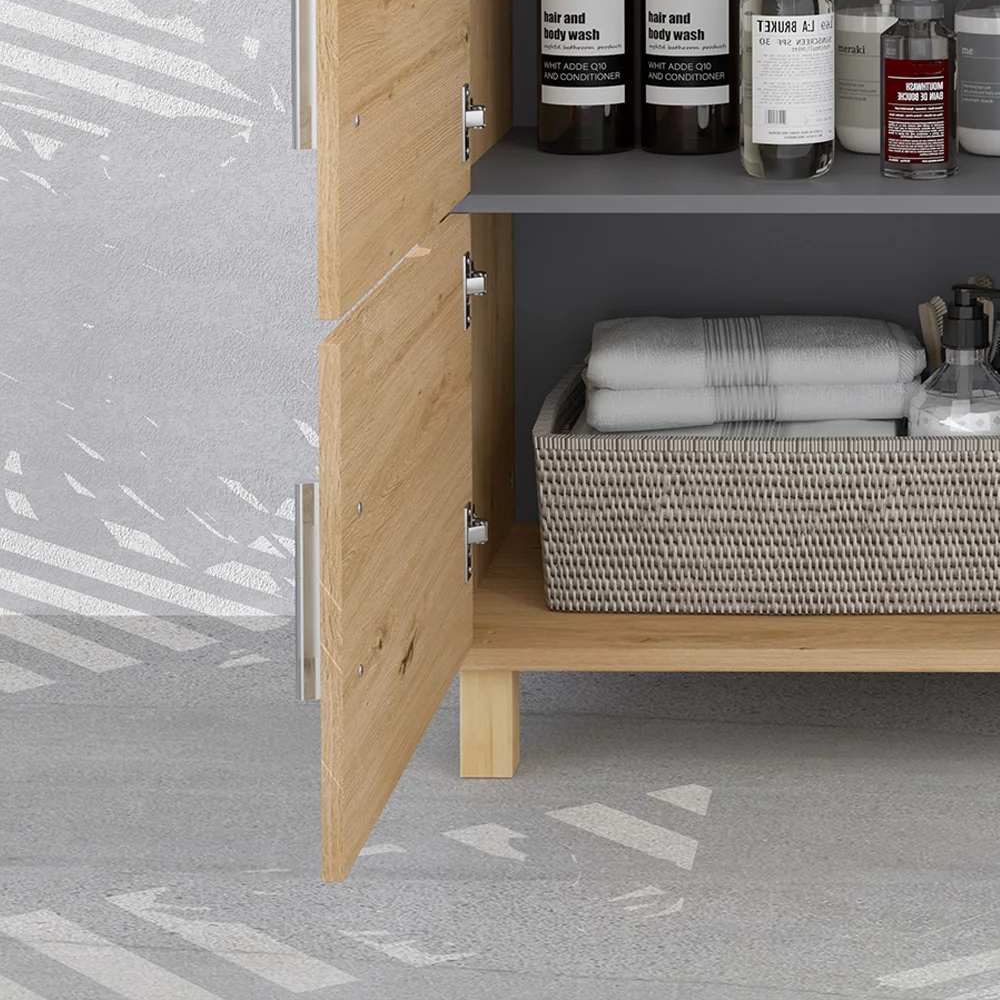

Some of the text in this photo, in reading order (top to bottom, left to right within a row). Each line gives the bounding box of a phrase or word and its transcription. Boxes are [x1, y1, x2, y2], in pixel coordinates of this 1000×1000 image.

[544, 11, 586, 25] hair and
[648, 11, 691, 25] hair and
[544, 27, 600, 42] body wash
[648, 27, 705, 42] body wash
[544, 62, 607, 72] WHIT ADDE Q10
[648, 62, 712, 72] WHIT ADDE Q10
[544, 72, 621, 81] AND CONDITIONER
[648, 72, 725, 81] AND CONDITIONER
